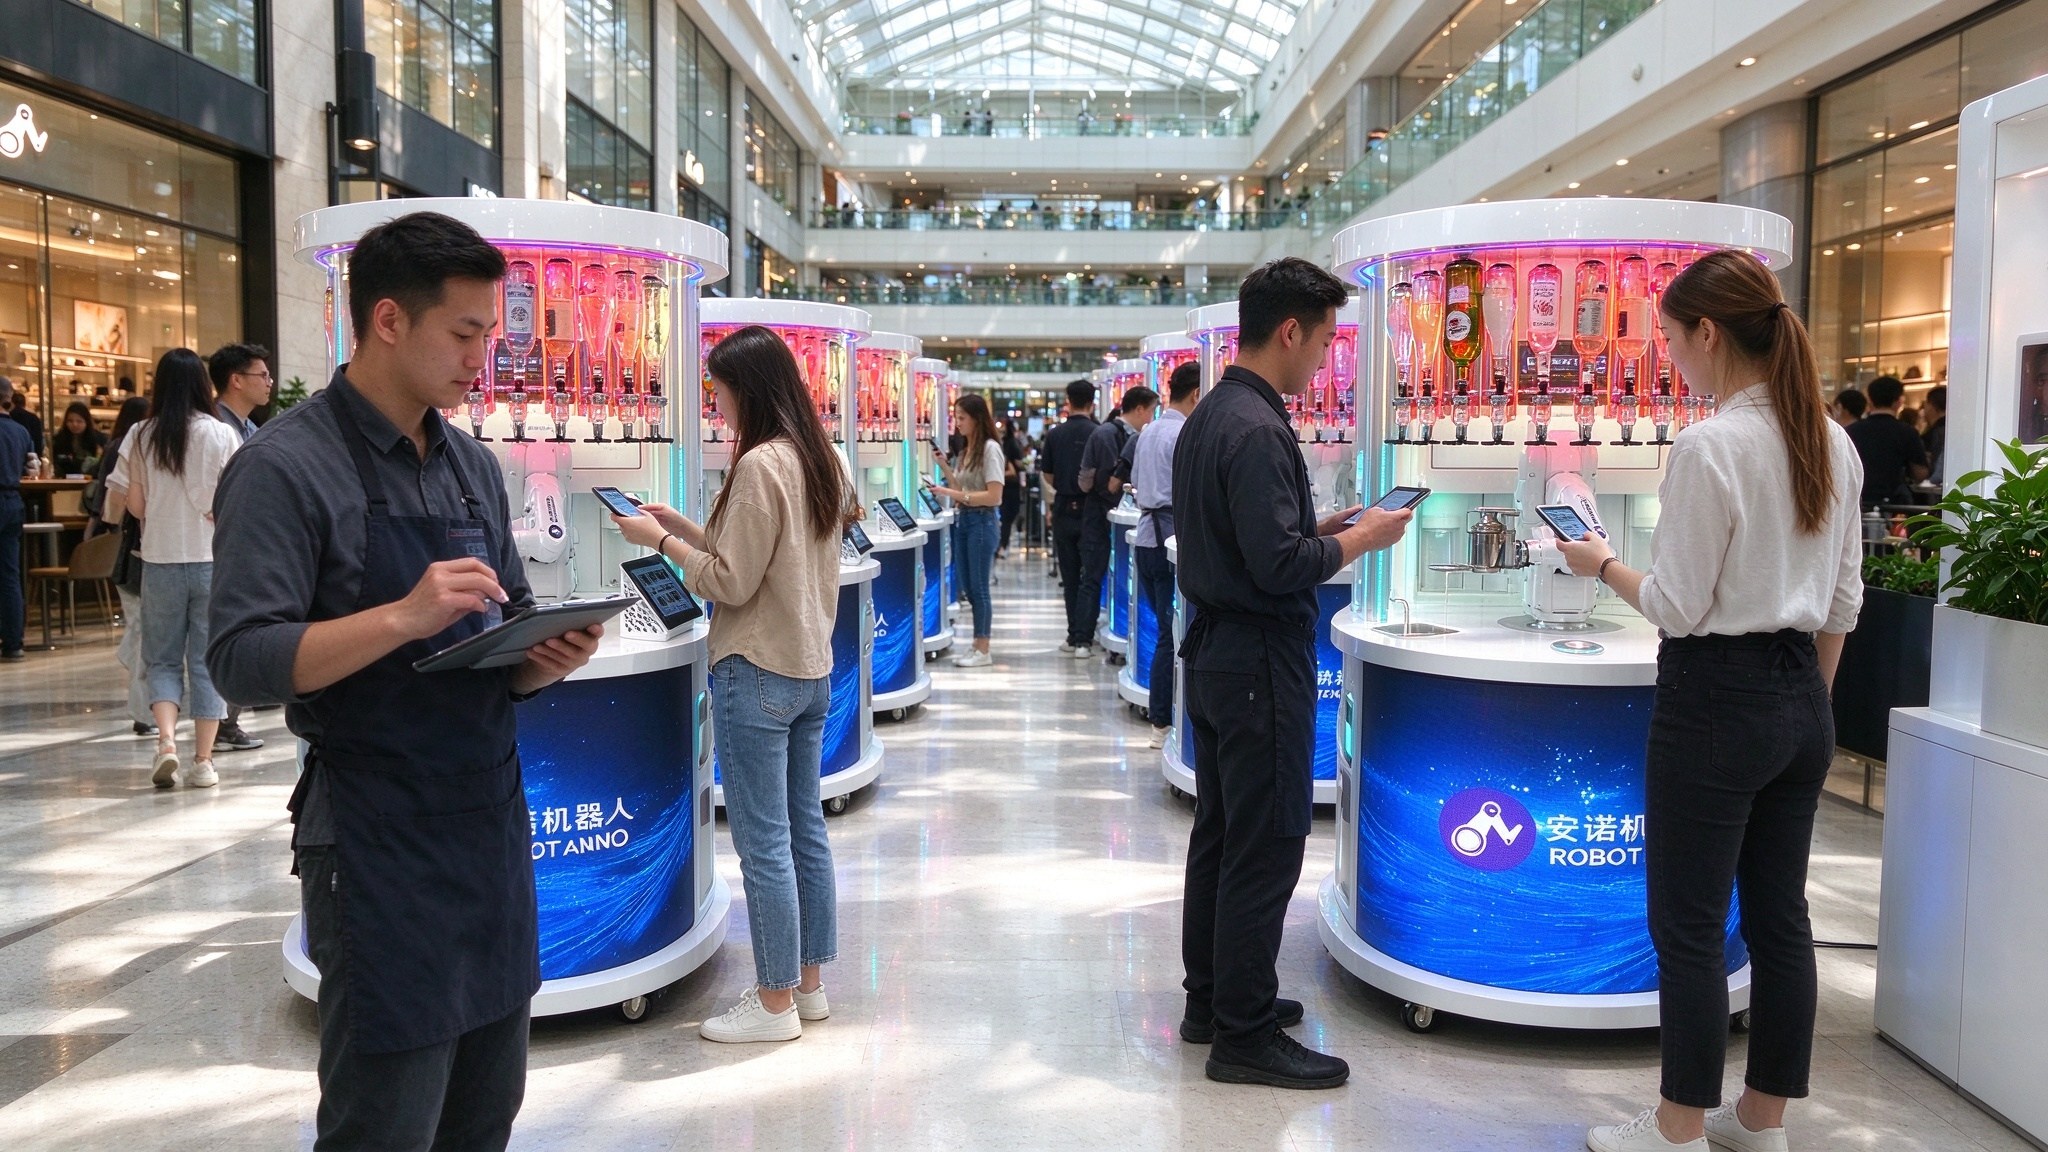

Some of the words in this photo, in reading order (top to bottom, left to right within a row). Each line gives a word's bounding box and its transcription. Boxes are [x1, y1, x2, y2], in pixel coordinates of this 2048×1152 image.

[529, 797, 634, 836] 机器人
[1546, 813, 1646, 843] 安诺机
[1549, 847, 1643, 867] ROBOT
